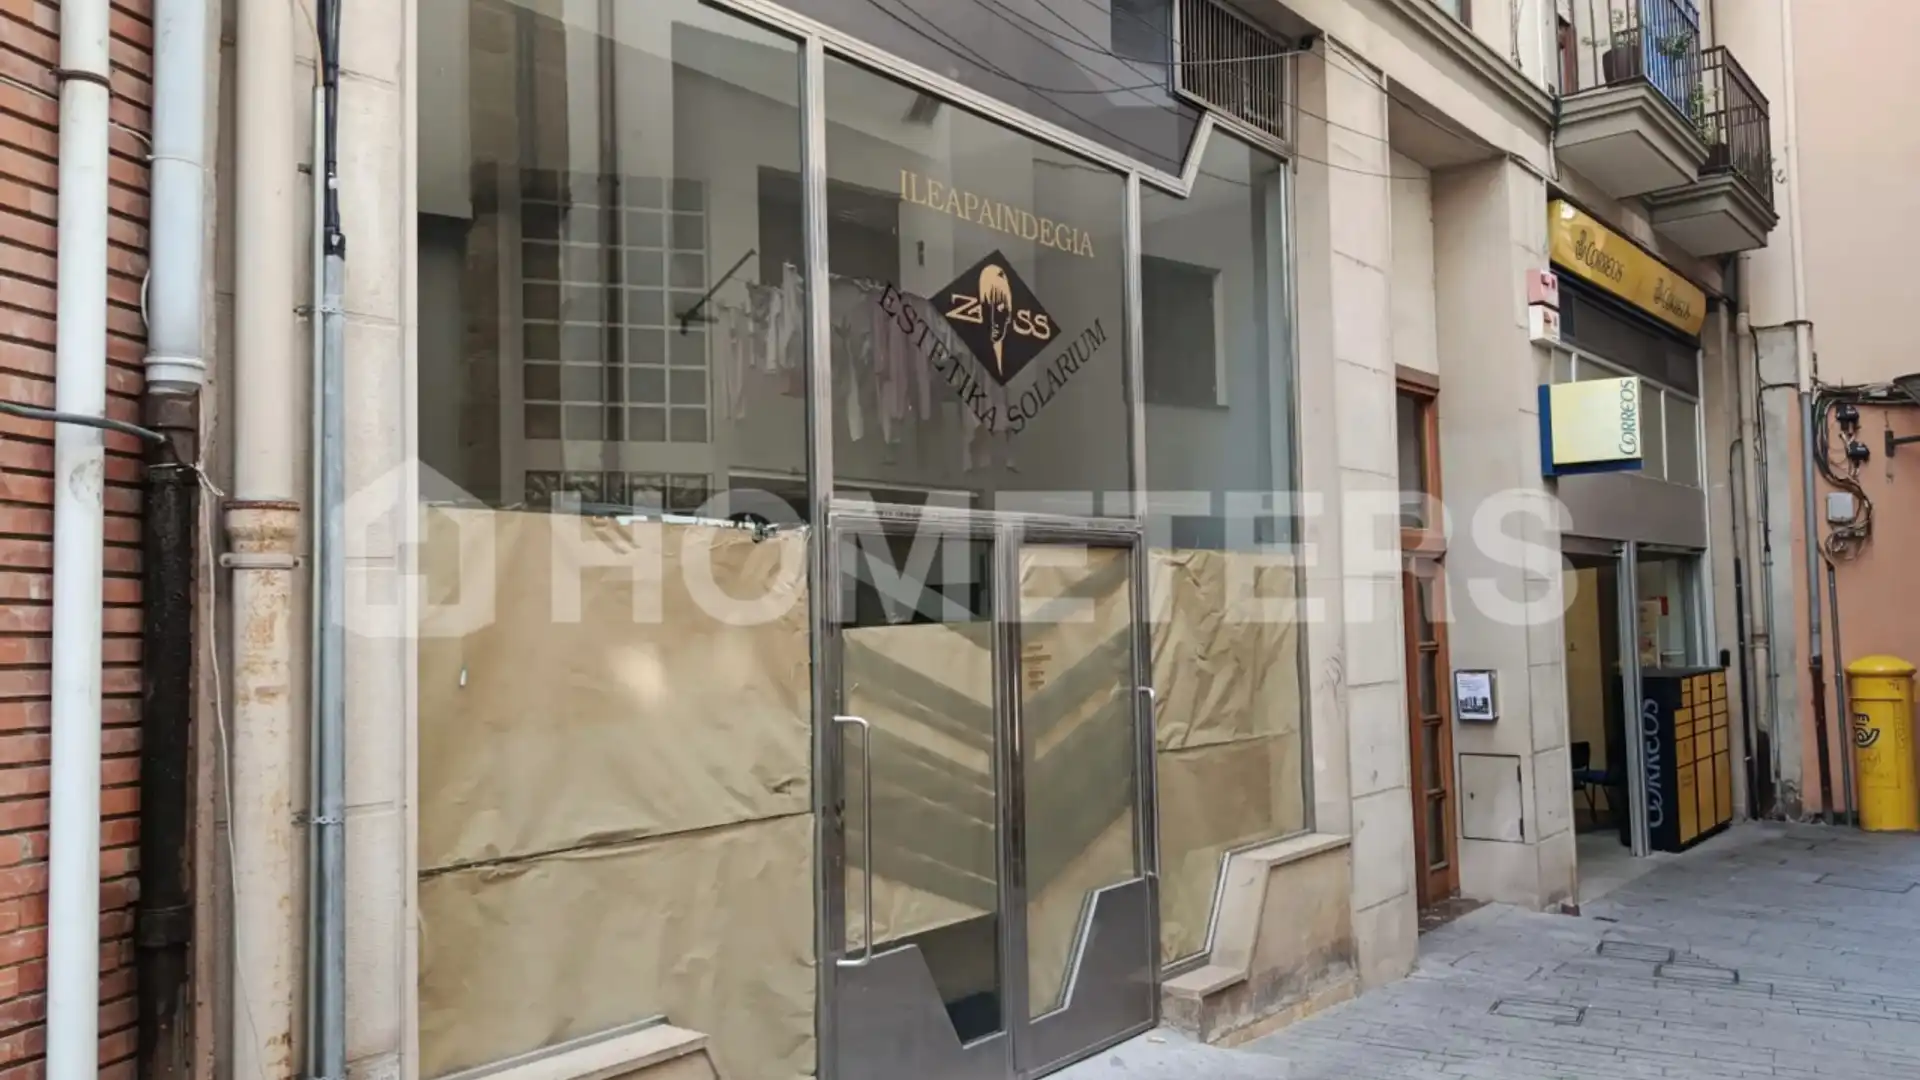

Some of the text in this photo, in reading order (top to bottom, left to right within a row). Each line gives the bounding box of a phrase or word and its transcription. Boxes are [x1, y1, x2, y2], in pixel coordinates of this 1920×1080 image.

[900, 169, 1095, 258] ILEAPAINDEGIA
[879, 283, 1108, 437] ESTETIKA SOLARIUM
[1619, 379, 1638, 456] CORREOS
